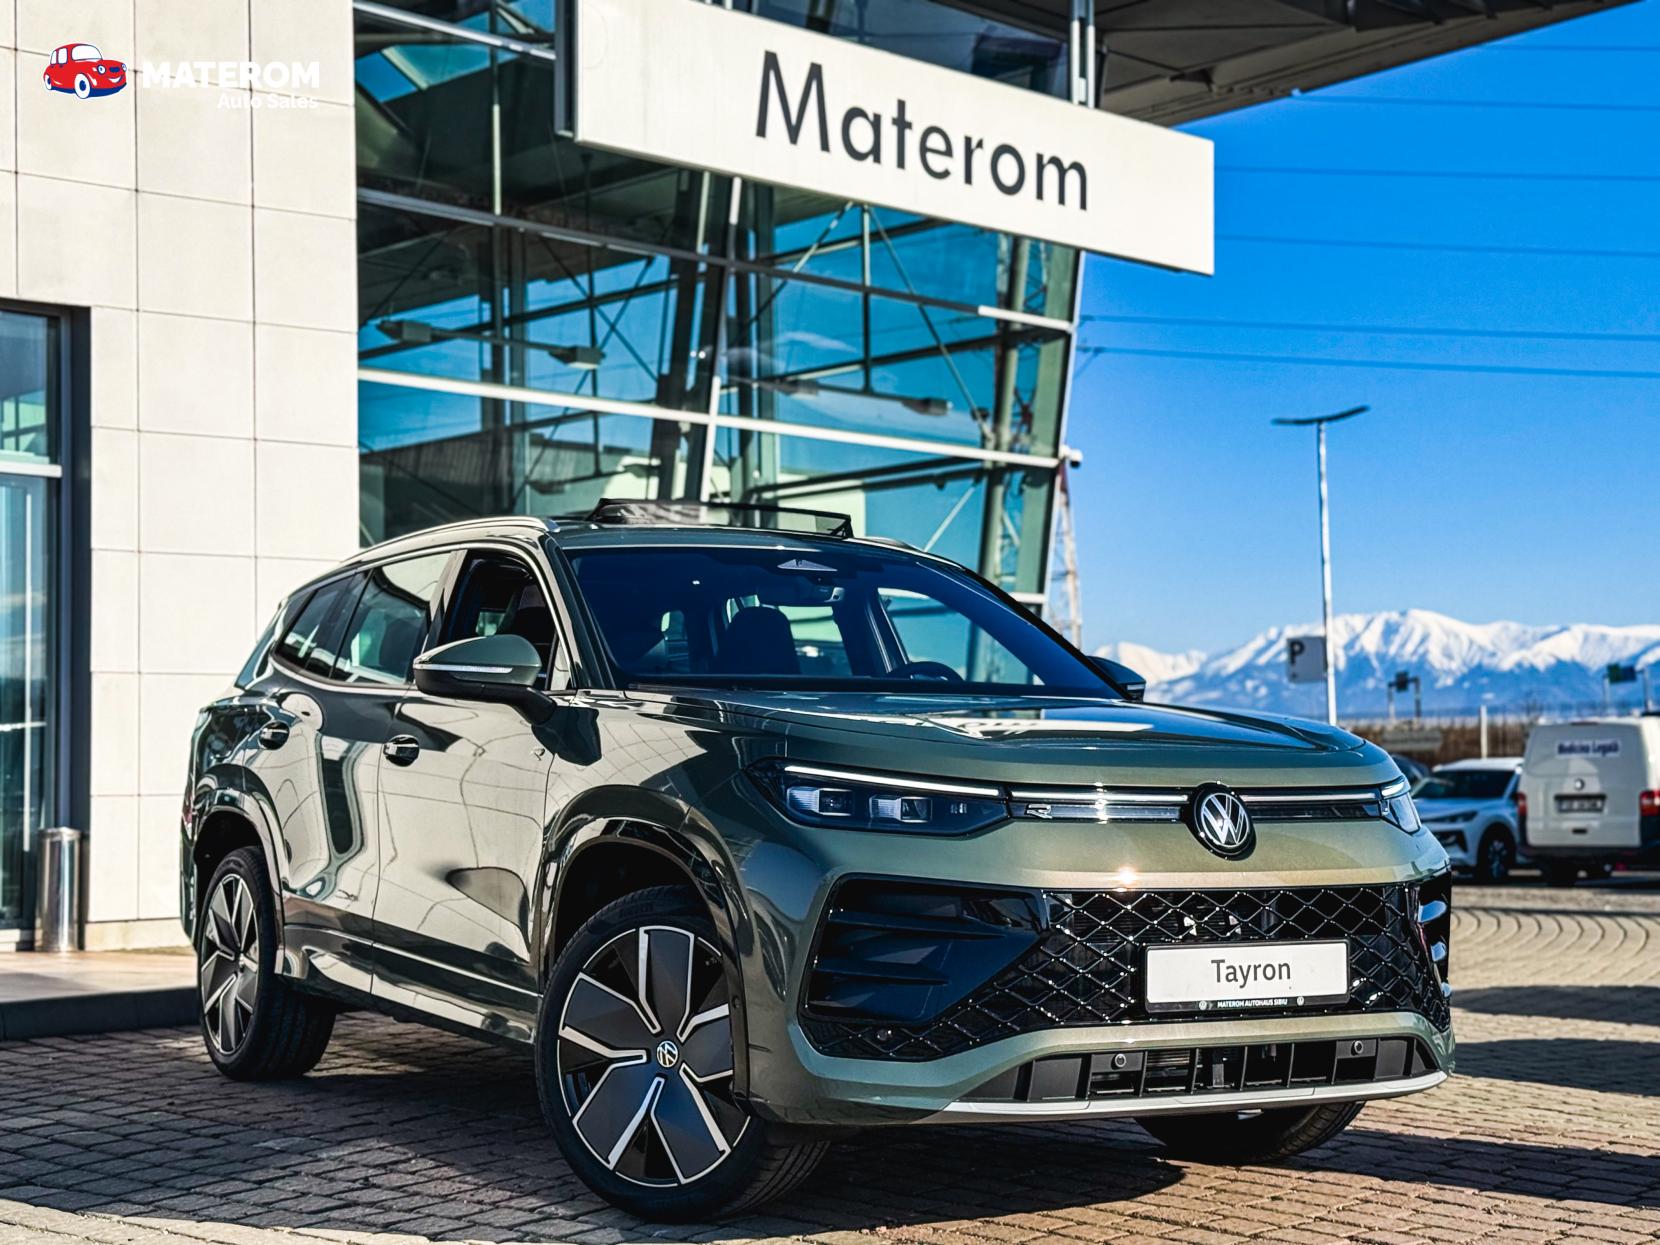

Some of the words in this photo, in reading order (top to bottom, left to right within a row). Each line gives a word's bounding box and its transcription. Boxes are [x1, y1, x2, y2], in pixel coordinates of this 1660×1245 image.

[755, 50, 1088, 211] Materom
[1210, 959, 1291, 989] Tayron
[1217, 1000, 1245, 1008] MATEROM
[1245, 999, 1274, 1007] AUTOHAUS
